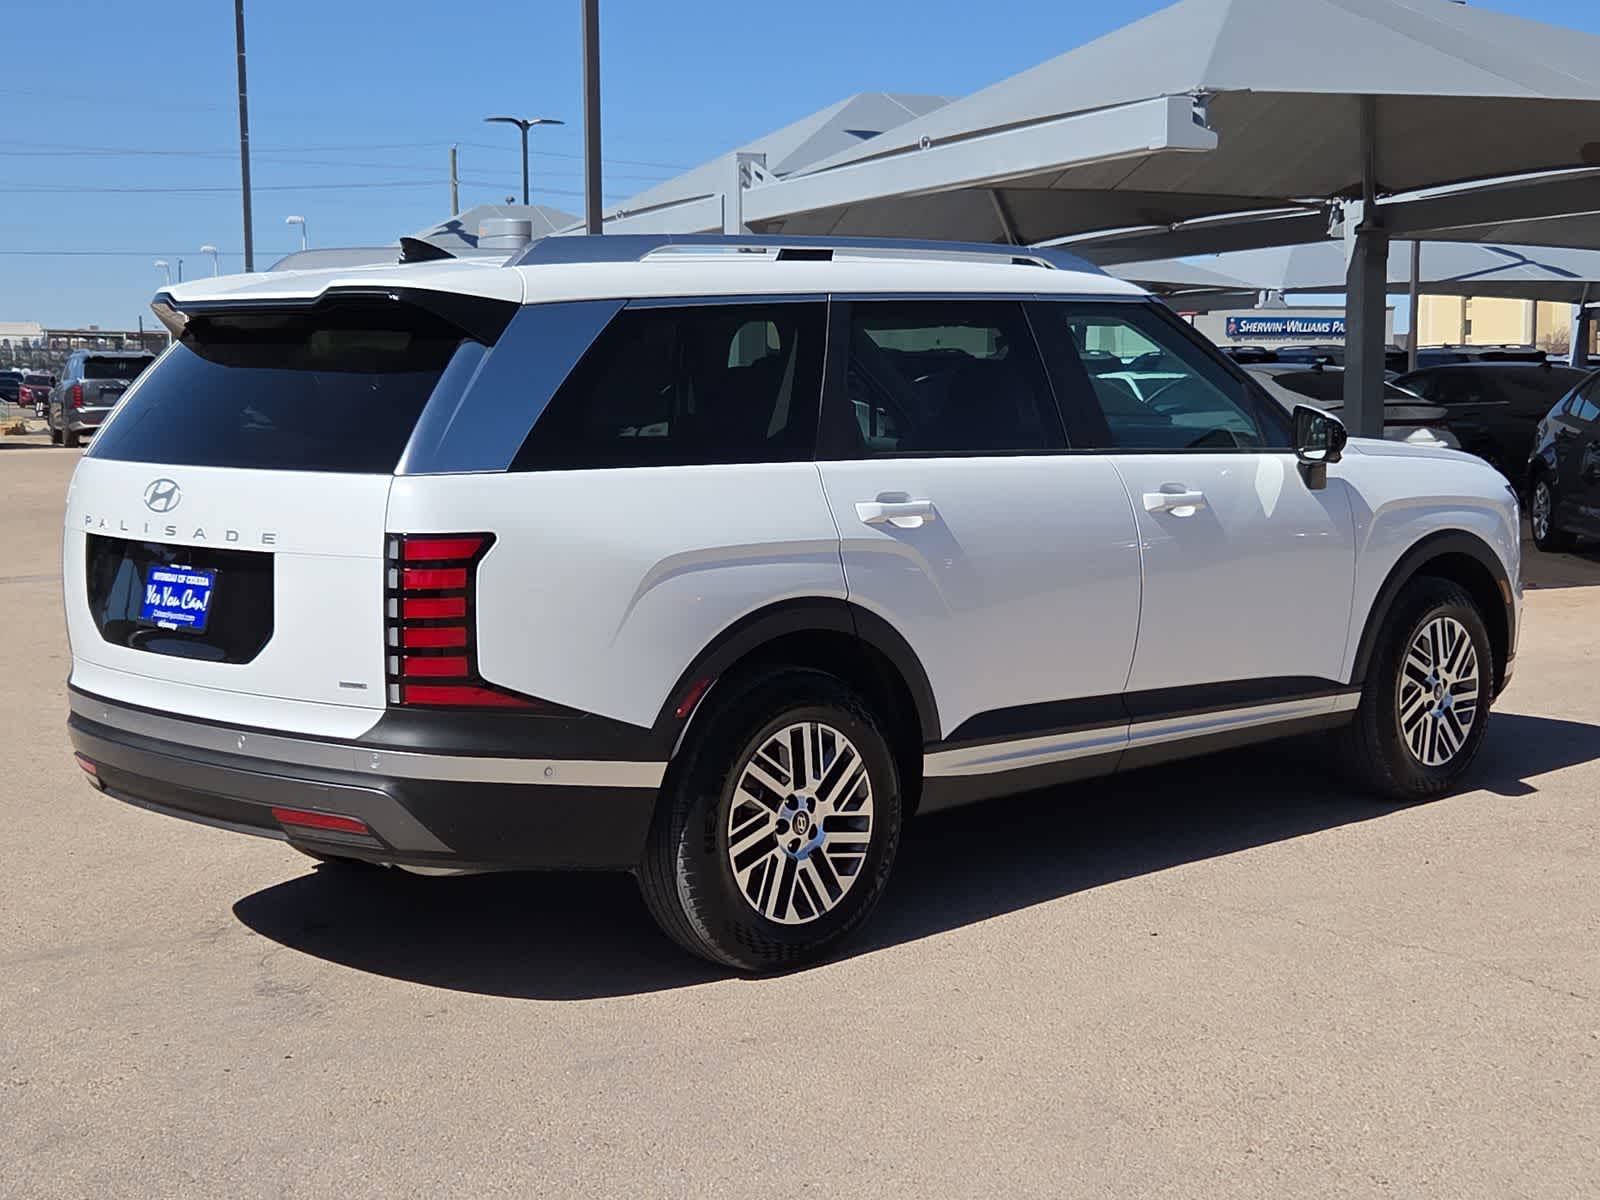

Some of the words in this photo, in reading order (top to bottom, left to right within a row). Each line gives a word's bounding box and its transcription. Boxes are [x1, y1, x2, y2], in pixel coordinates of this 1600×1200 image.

[1239, 320, 1330, 333] SHERWIN-WILLIAMS
[85, 515, 276, 545] PALISADE
[161, 586, 180, 607] You
[181, 589, 211, 612] Can!
